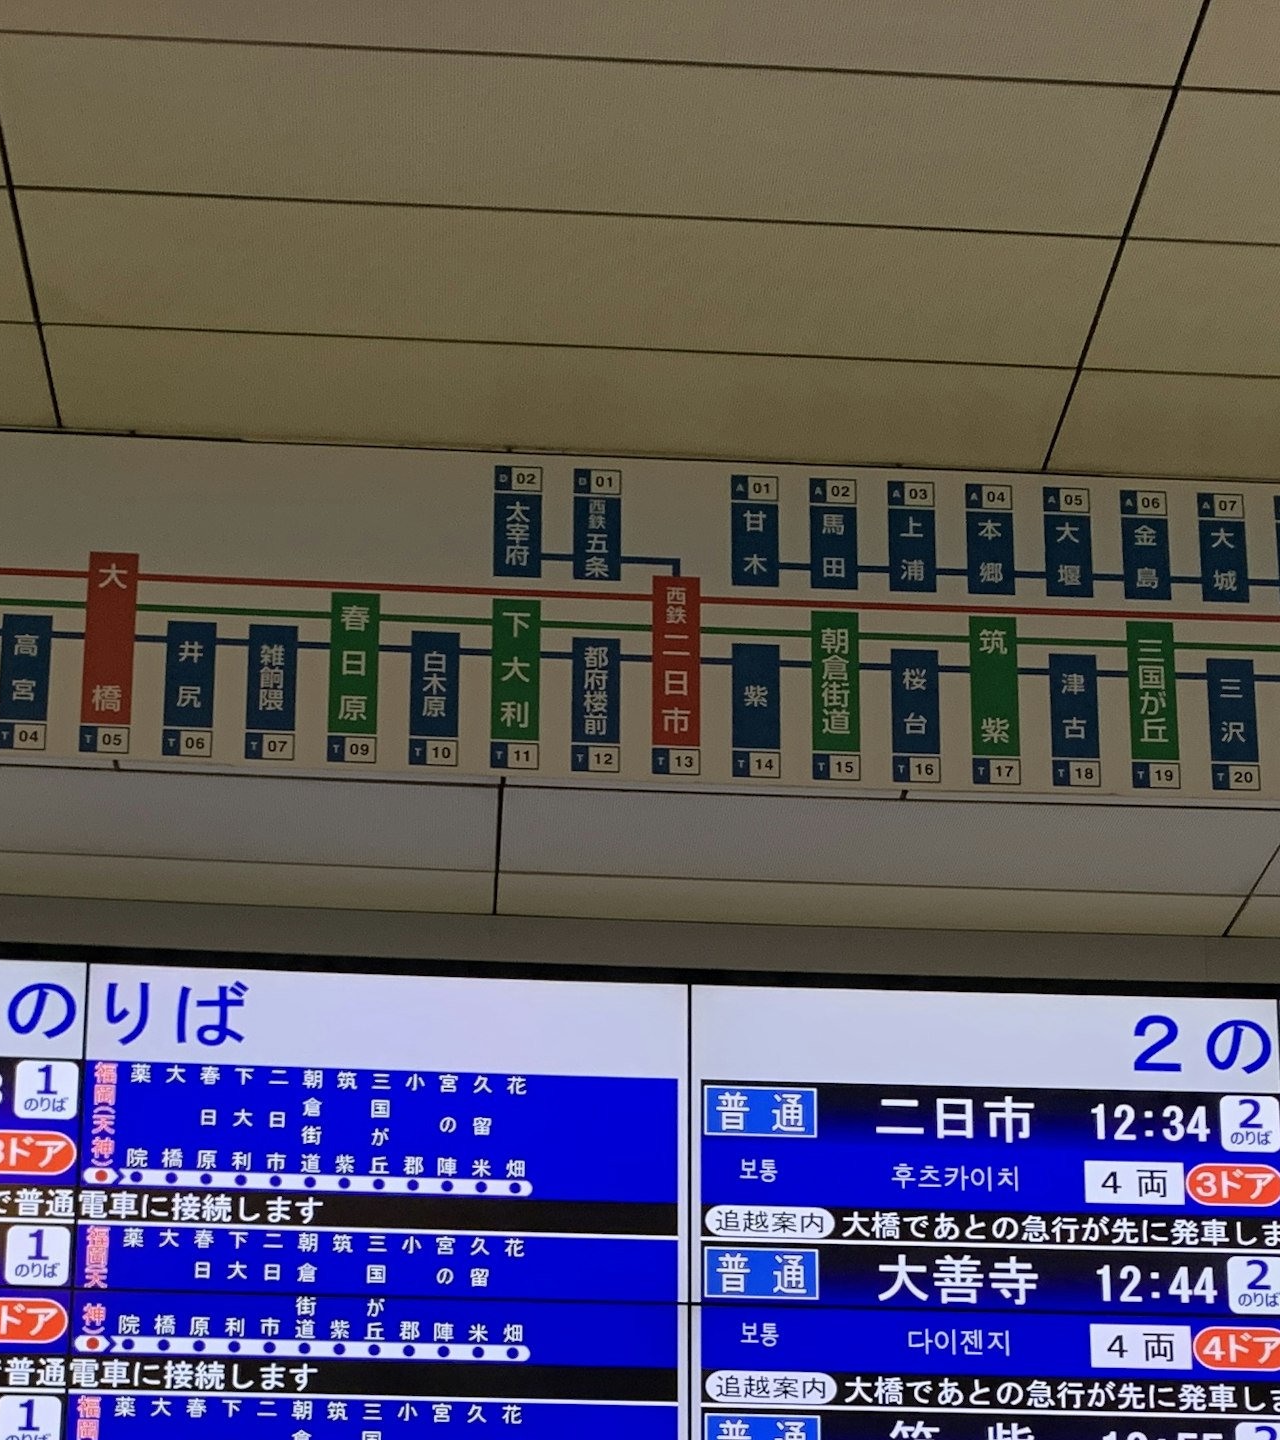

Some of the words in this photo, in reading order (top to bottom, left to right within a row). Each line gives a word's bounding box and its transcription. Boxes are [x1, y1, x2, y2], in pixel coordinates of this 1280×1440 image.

[515, 471, 537, 485] 02
[750, 481, 771, 495] 01
[503, 501, 532, 567] 太宰府
[583, 498, 610, 579] 西鉄五条
[742, 510, 769, 576] 甘木
[977, 519, 1004, 585] 本郷
[1133, 525, 1160, 590] 金島
[89, 561, 130, 714] 大橋
[335, 603, 373, 722] 春日原
[661, 586, 691, 734] 西鉄二日市
[498, 609, 533, 727] 下大利
[820, 626, 852, 736] 朝倉街道
[978, 627, 1011, 745] 筑紫
[1137, 638, 1169, 744] 三国が丘
[23, 1095, 69, 1114] のりば
[36, 1064, 59, 1096] 1
[299, 1068, 325, 1174] 朝倉街道
[368, 1072, 392, 1176] 三国が丘
[715, 1091, 807, 1133] 普通
[874, 1095, 1037, 1144] 二日市
[1090, 1103, 1211, 1144] 12:34
[1229, 1129, 1274, 1147] のりば
[1236, 1098, 1265, 1130] 2
[739, 1157, 778, 1183] 보통
[890, 1162, 1022, 1193] 후츠카이치
[1100, 1169, 1169, 1197] 4両
[1194, 1168, 1277, 1202] 3ドア
[714, 1209, 826, 1234] 追越案内
[715, 1253, 807, 1295] 普通
[876, 1254, 1040, 1306] 大善寺
[1095, 1265, 1219, 1305] 12:44
[906, 1327, 1012, 1357] 다이젠지
[1106, 1333, 1176, 1362] 4両
[715, 1376, 827, 1400] 追越案内
